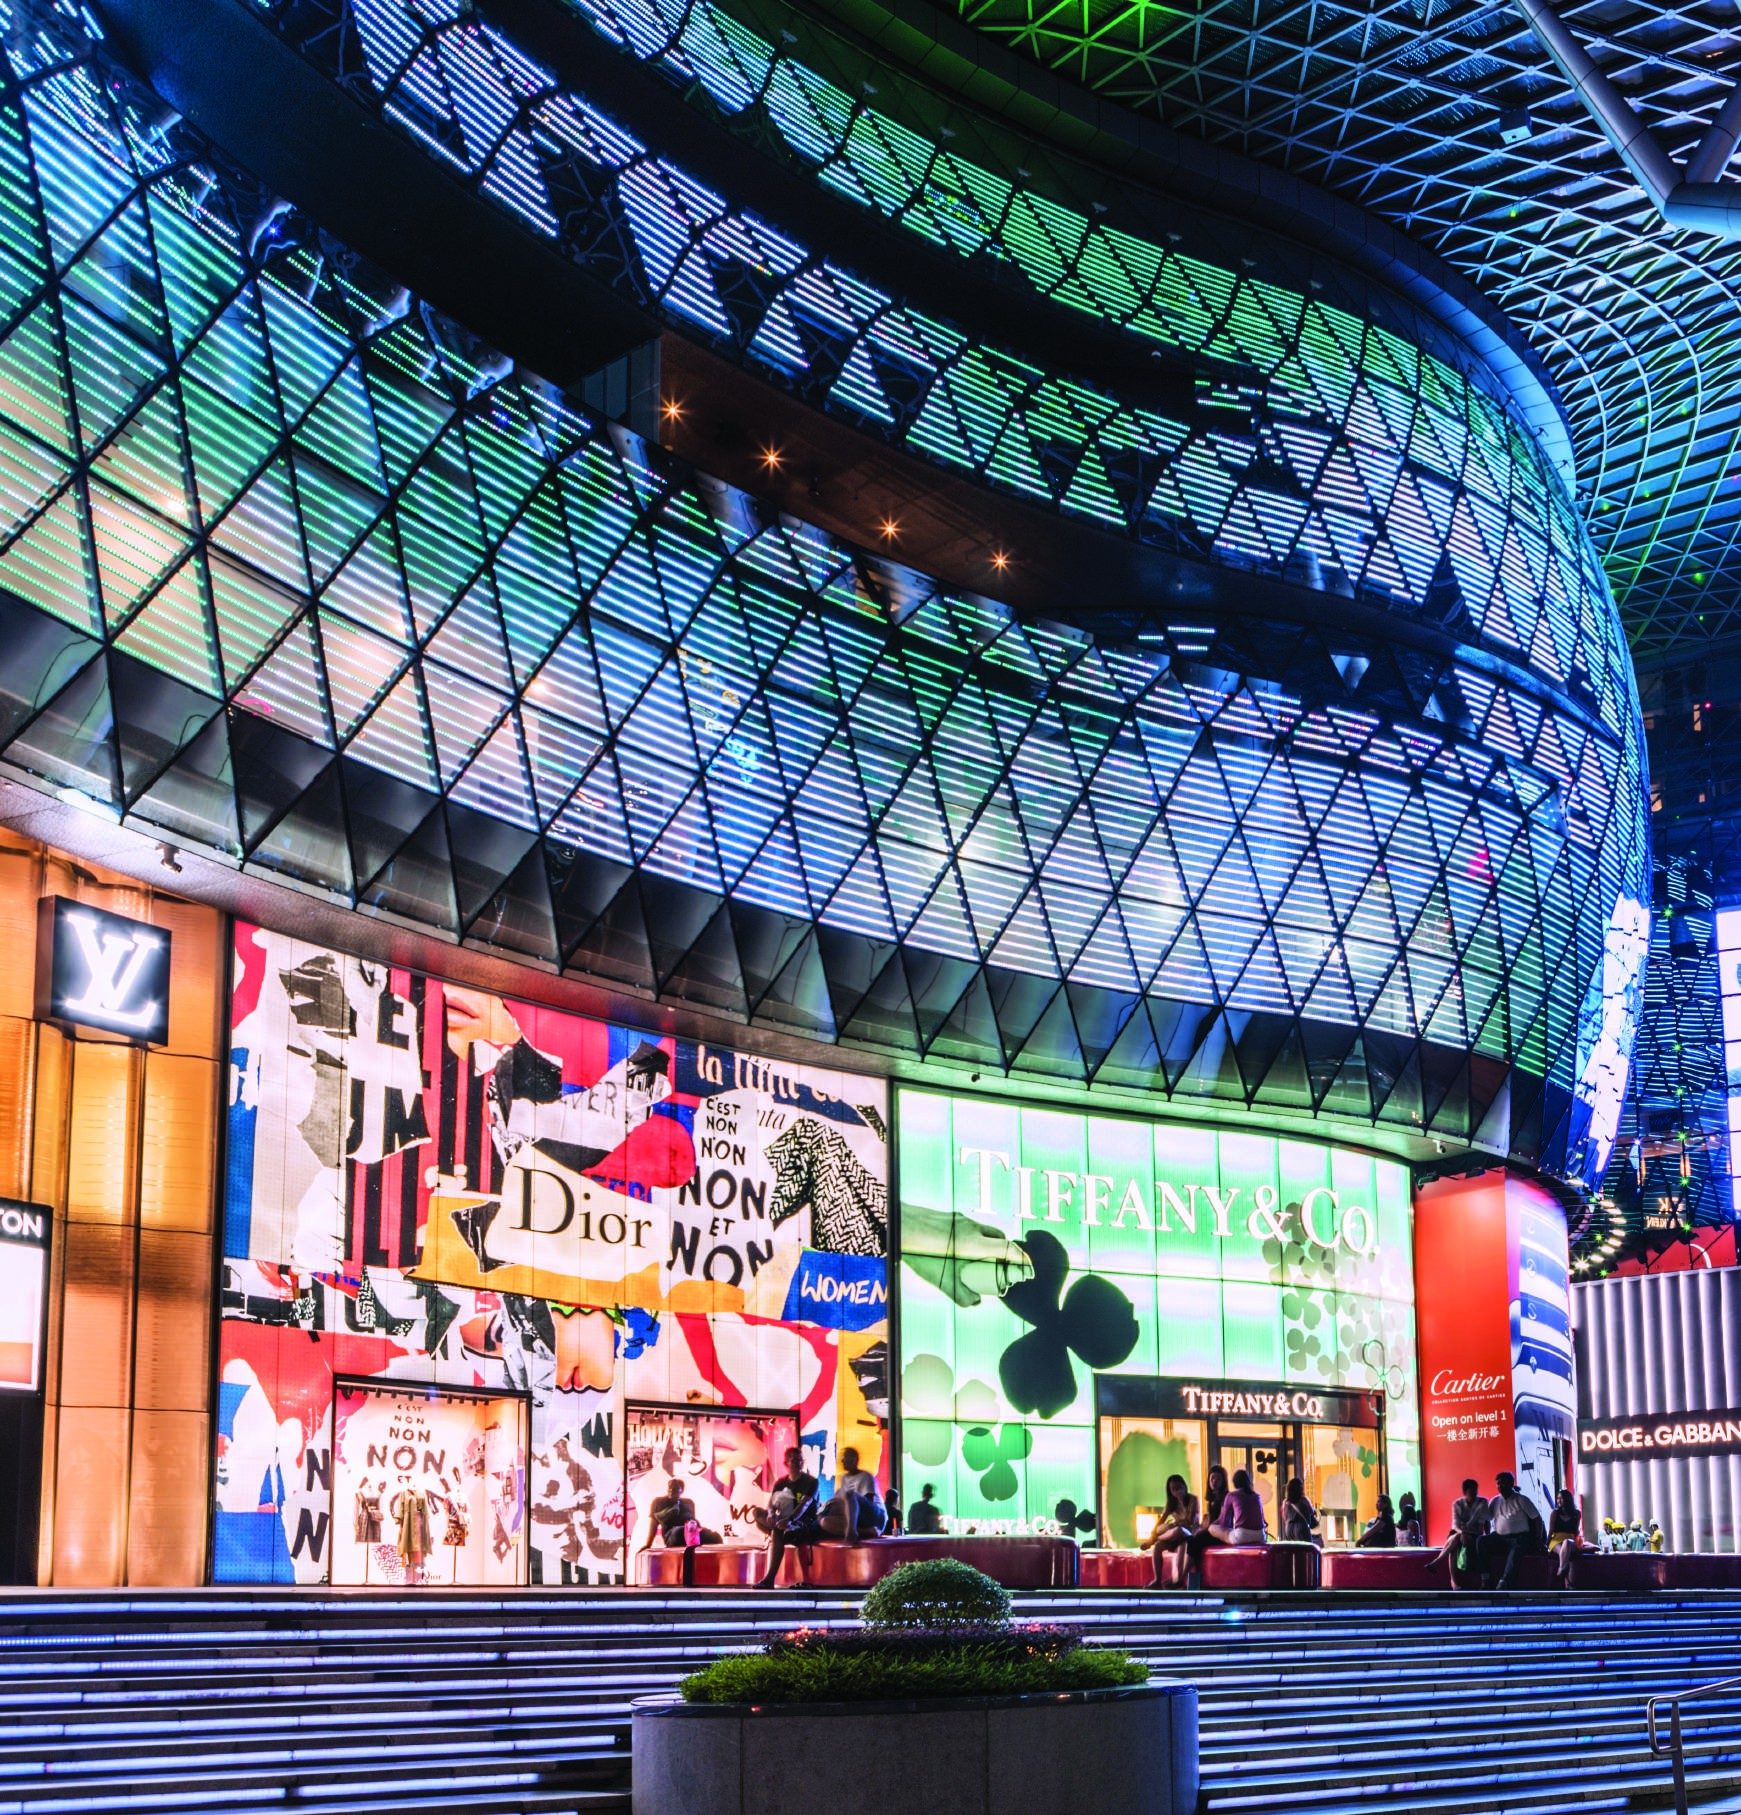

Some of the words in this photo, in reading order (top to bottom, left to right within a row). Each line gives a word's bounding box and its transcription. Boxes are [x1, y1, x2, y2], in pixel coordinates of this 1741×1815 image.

[706, 1116, 738, 1135] NON
[701, 1137, 746, 1166] NON
[509, 1165, 653, 1248] Dior
[678, 1165, 767, 1221] NON
[0, 1208, 43, 1238] ON
[709, 1217, 736, 1236] ET
[666, 1220, 774, 1287] NON
[801, 1269, 888, 1305] WOMEN
[1430, 1369, 1505, 1396] Cartier
[394, 1414, 425, 1425] NON
[1431, 1415, 1458, 1428] Open
[1460, 1415, 1473, 1425] on
[1475, 1409, 1498, 1423] level
[1500, 1409, 1507, 1421] 1
[389, 1426, 431, 1443] NON
[1437, 1425, 1500, 1442] 一楼全新开幕
[366, 1443, 446, 1475] NON
